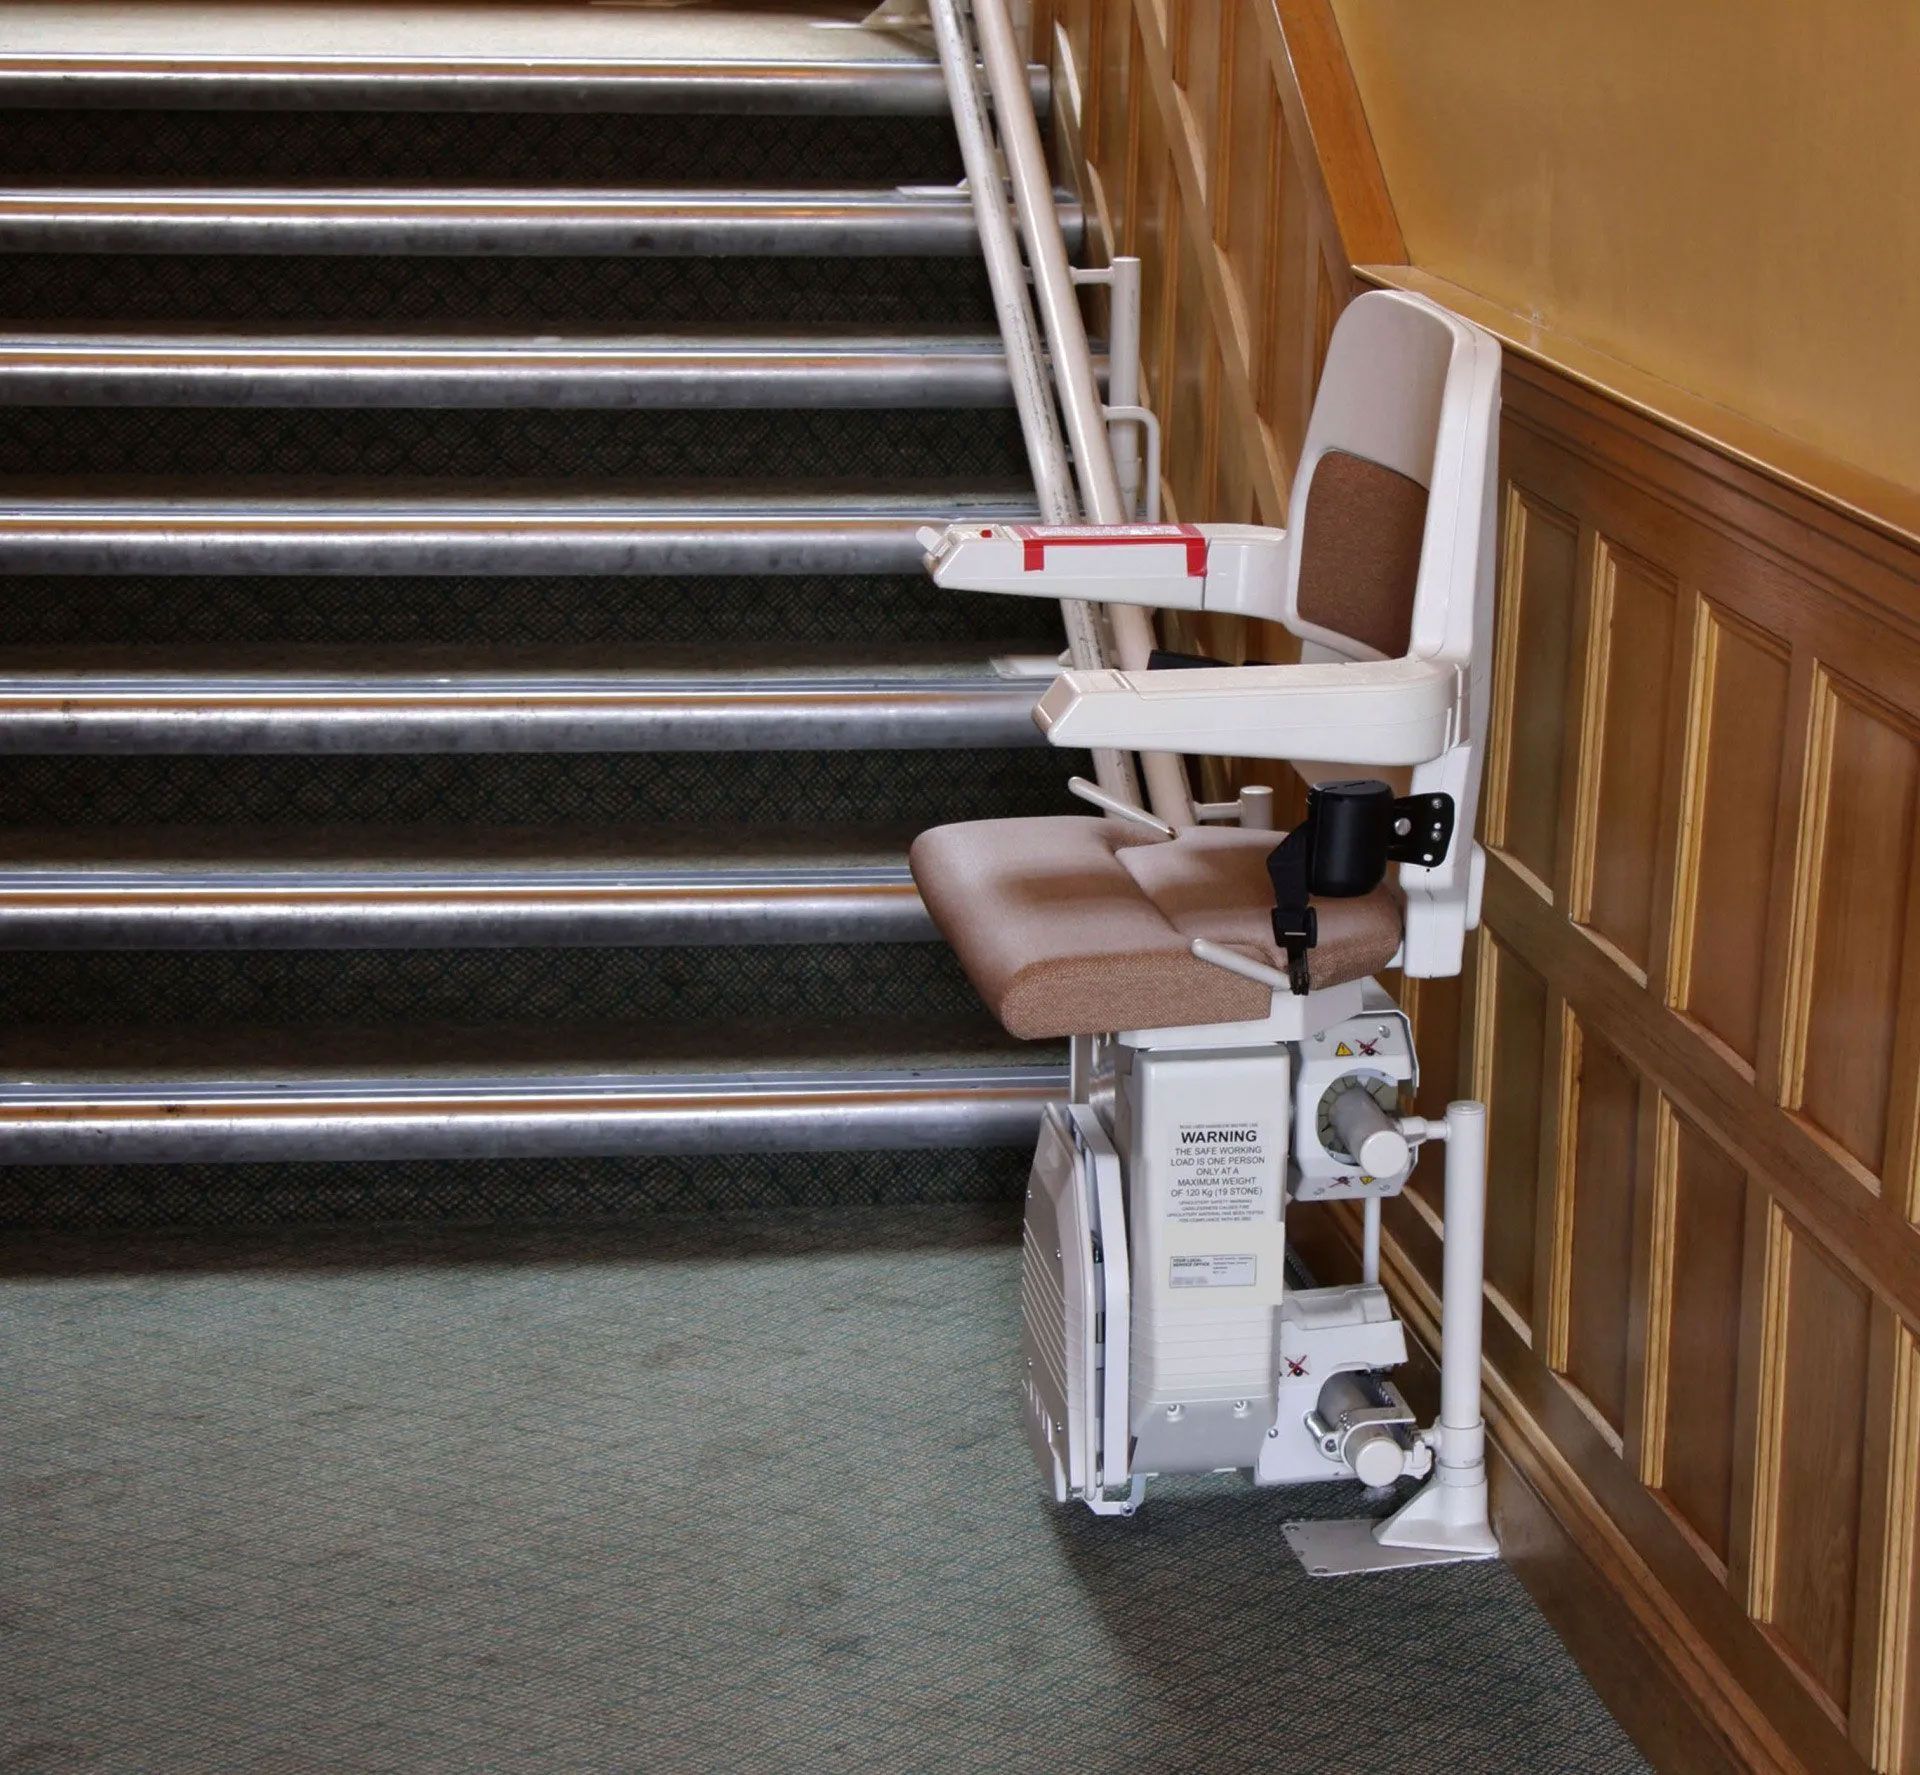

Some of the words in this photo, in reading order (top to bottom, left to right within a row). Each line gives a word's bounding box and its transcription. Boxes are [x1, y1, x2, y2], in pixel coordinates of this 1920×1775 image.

[1181, 1130, 1257, 1143] WARNING
[1195, 1147, 1217, 1155] SAFE
[1220, 1146, 1262, 1154] WORKING
[1170, 1158, 1194, 1166] LOAD
[1207, 1157, 1225, 1165] ONE
[1228, 1156, 1265, 1164] PERSON
[1221, 1167, 1231, 1175] AT
[1178, 1178, 1220, 1186] MAXIMUM
[1222, 1177, 1256, 1185] WEIGHT
[1171, 1189, 1183, 1197] OF
[1186, 1189, 1200, 1197] 120
[1201, 1189, 1213, 1198] Kg
[1214, 1188, 1228, 1197] (19
[1229, 1187, 1263, 1197] STONE)
